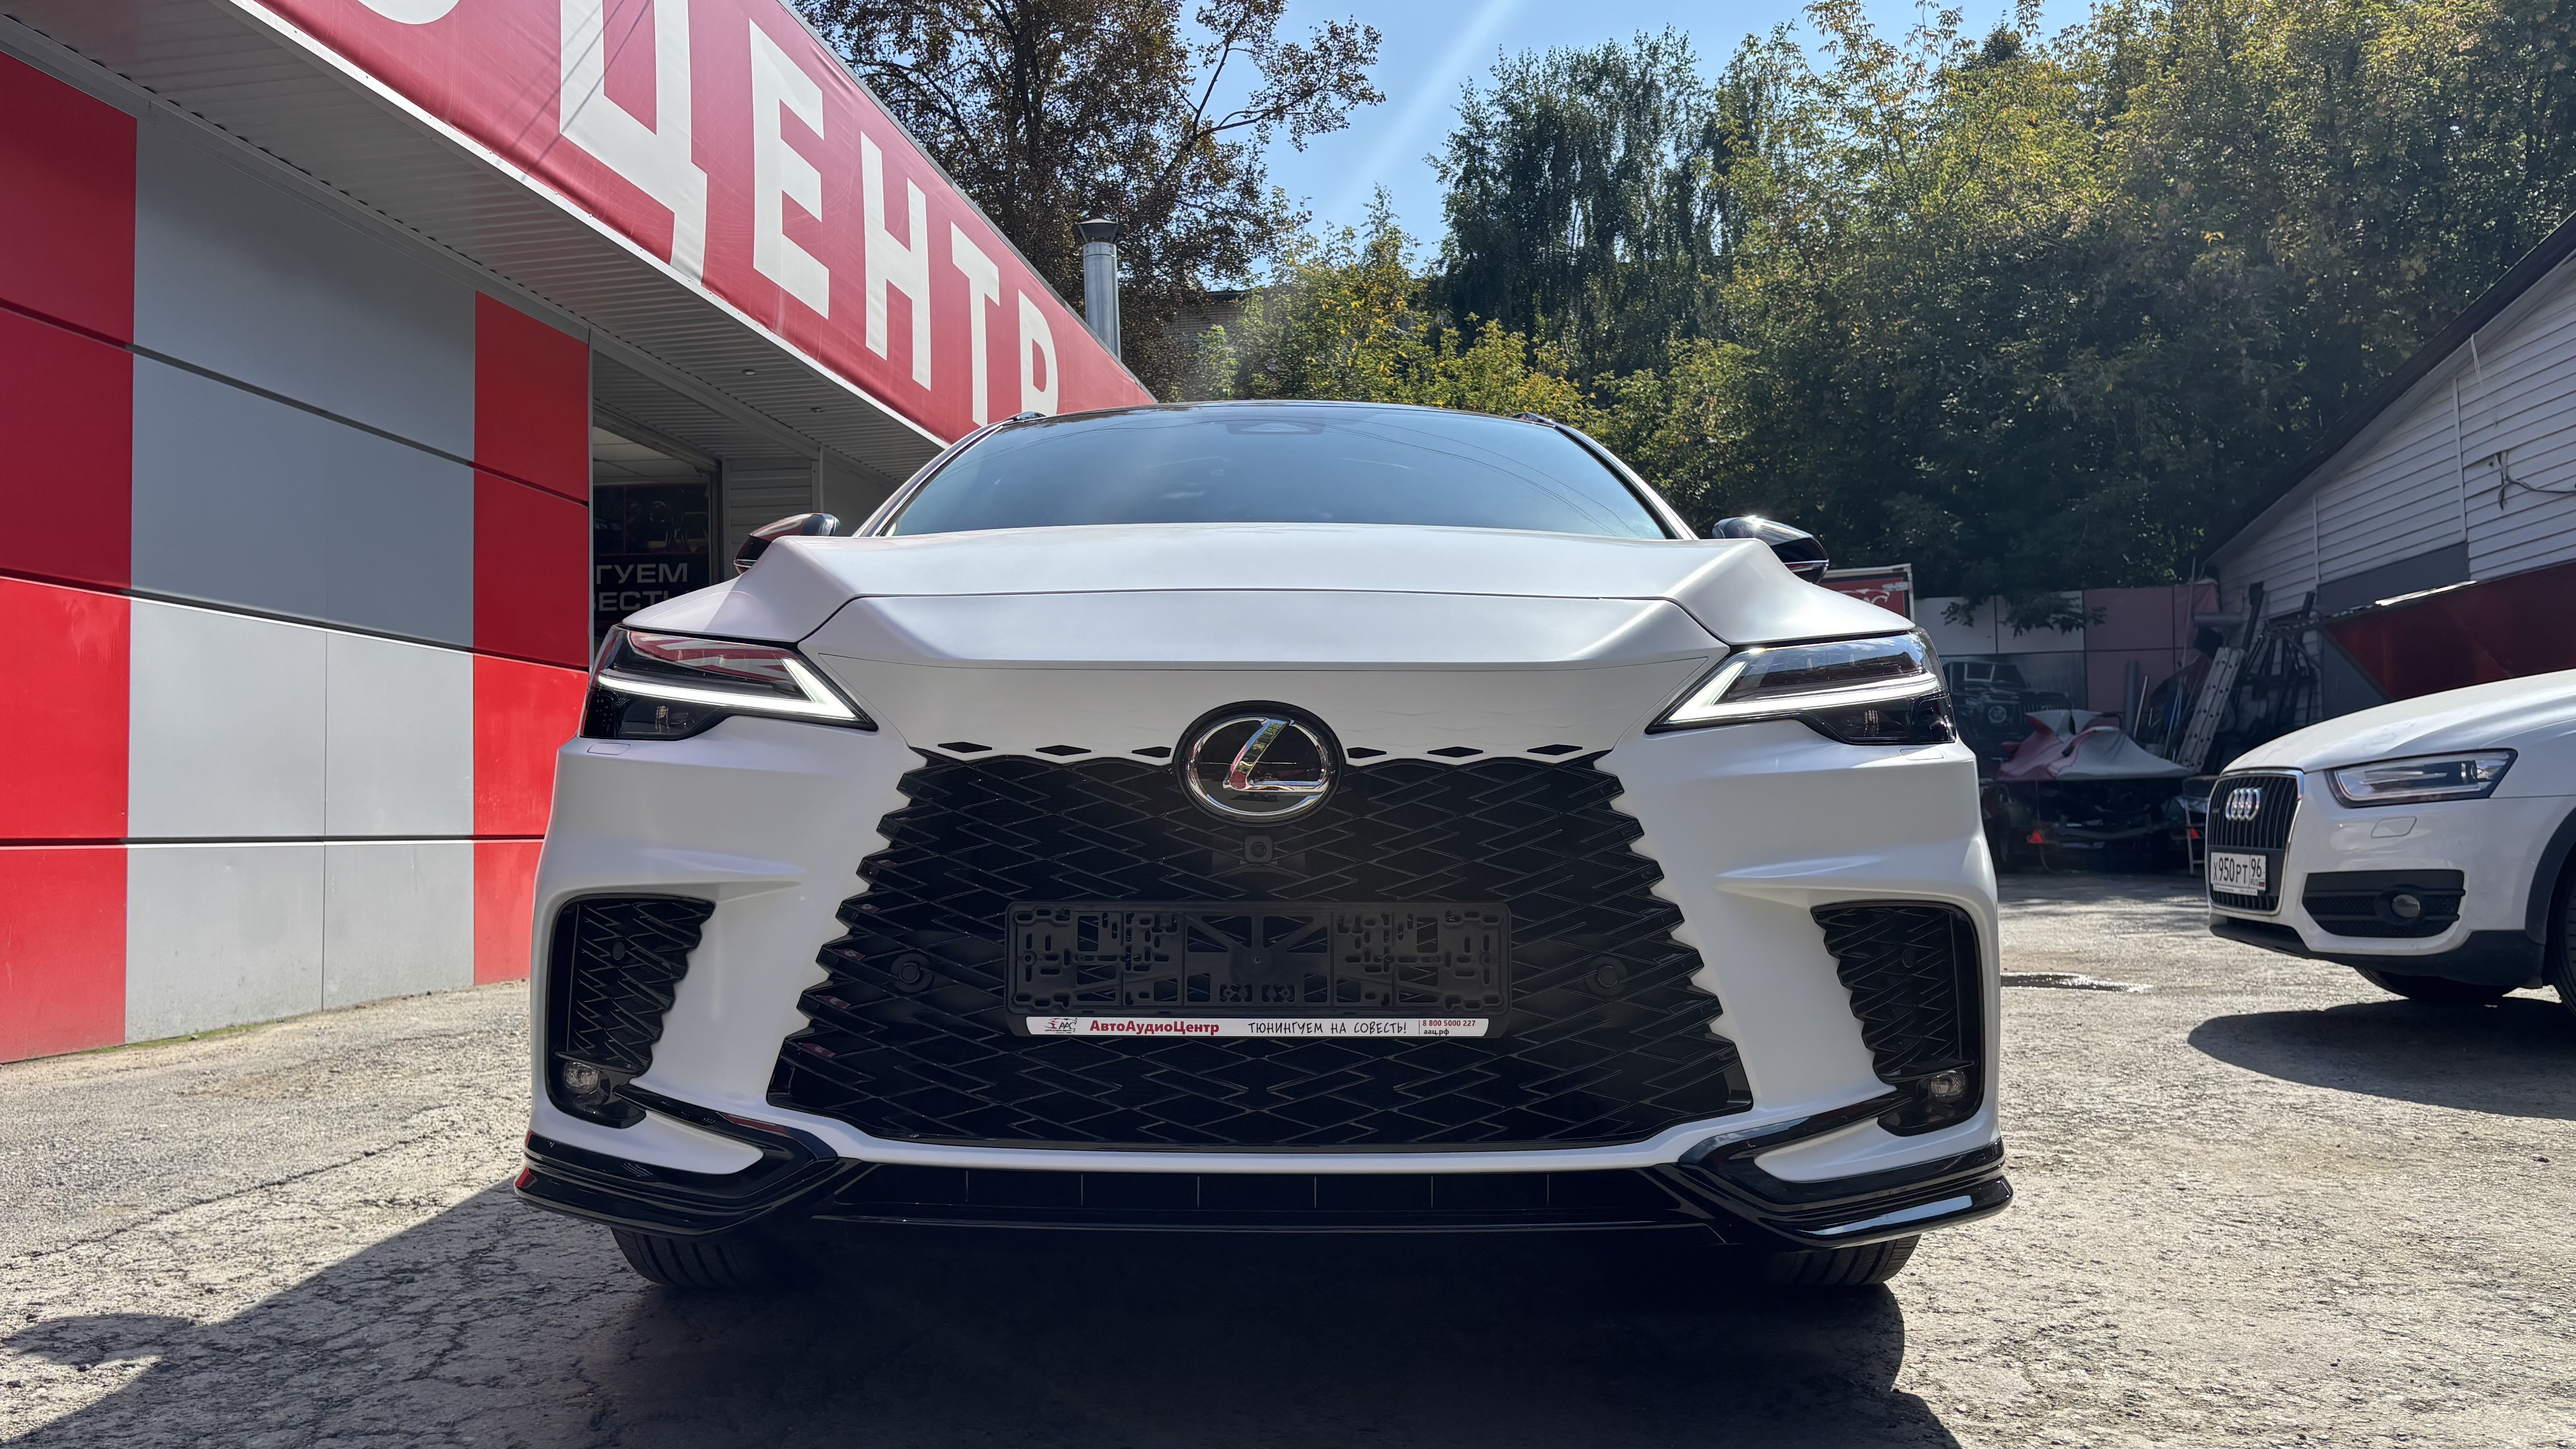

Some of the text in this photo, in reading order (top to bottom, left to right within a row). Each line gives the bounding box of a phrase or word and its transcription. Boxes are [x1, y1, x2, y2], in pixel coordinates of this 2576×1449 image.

[358, 0, 1058, 428] ЦЕНТР
[596, 563, 688, 584] ГУЕМ
[594, 590, 691, 611] ЕСТ
[1090, 1020, 1219, 1035] АвтоАудиоЦентр
[1248, 1021, 1407, 1035] ТЮНИНГУЕМ НА СОВЕСТЬ!
[1423, 1028, 1449, 1036] аац.рф
